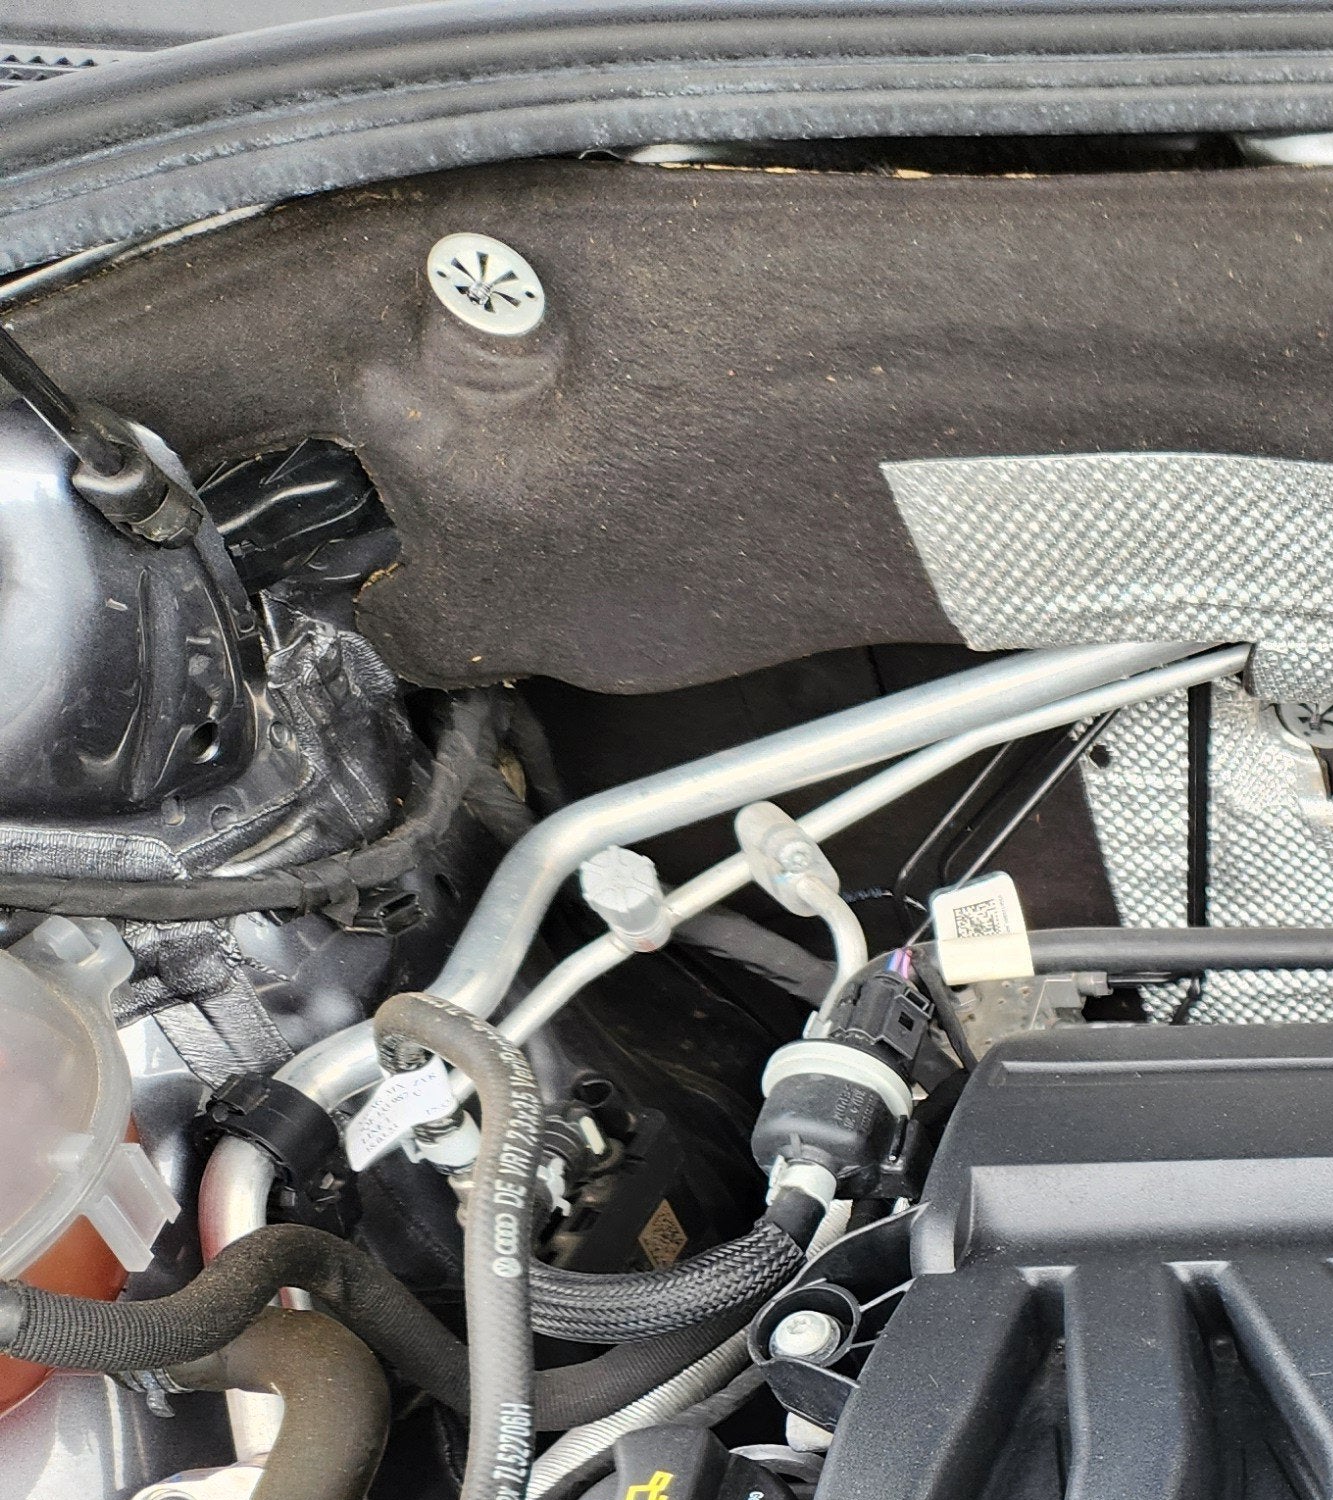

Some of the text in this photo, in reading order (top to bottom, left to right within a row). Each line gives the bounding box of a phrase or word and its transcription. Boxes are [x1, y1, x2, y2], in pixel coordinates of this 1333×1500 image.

[498, 1143, 537, 1178] VRT
[494, 1179, 528, 1209] DE
[493, 1402, 533, 1485] TL52706H
